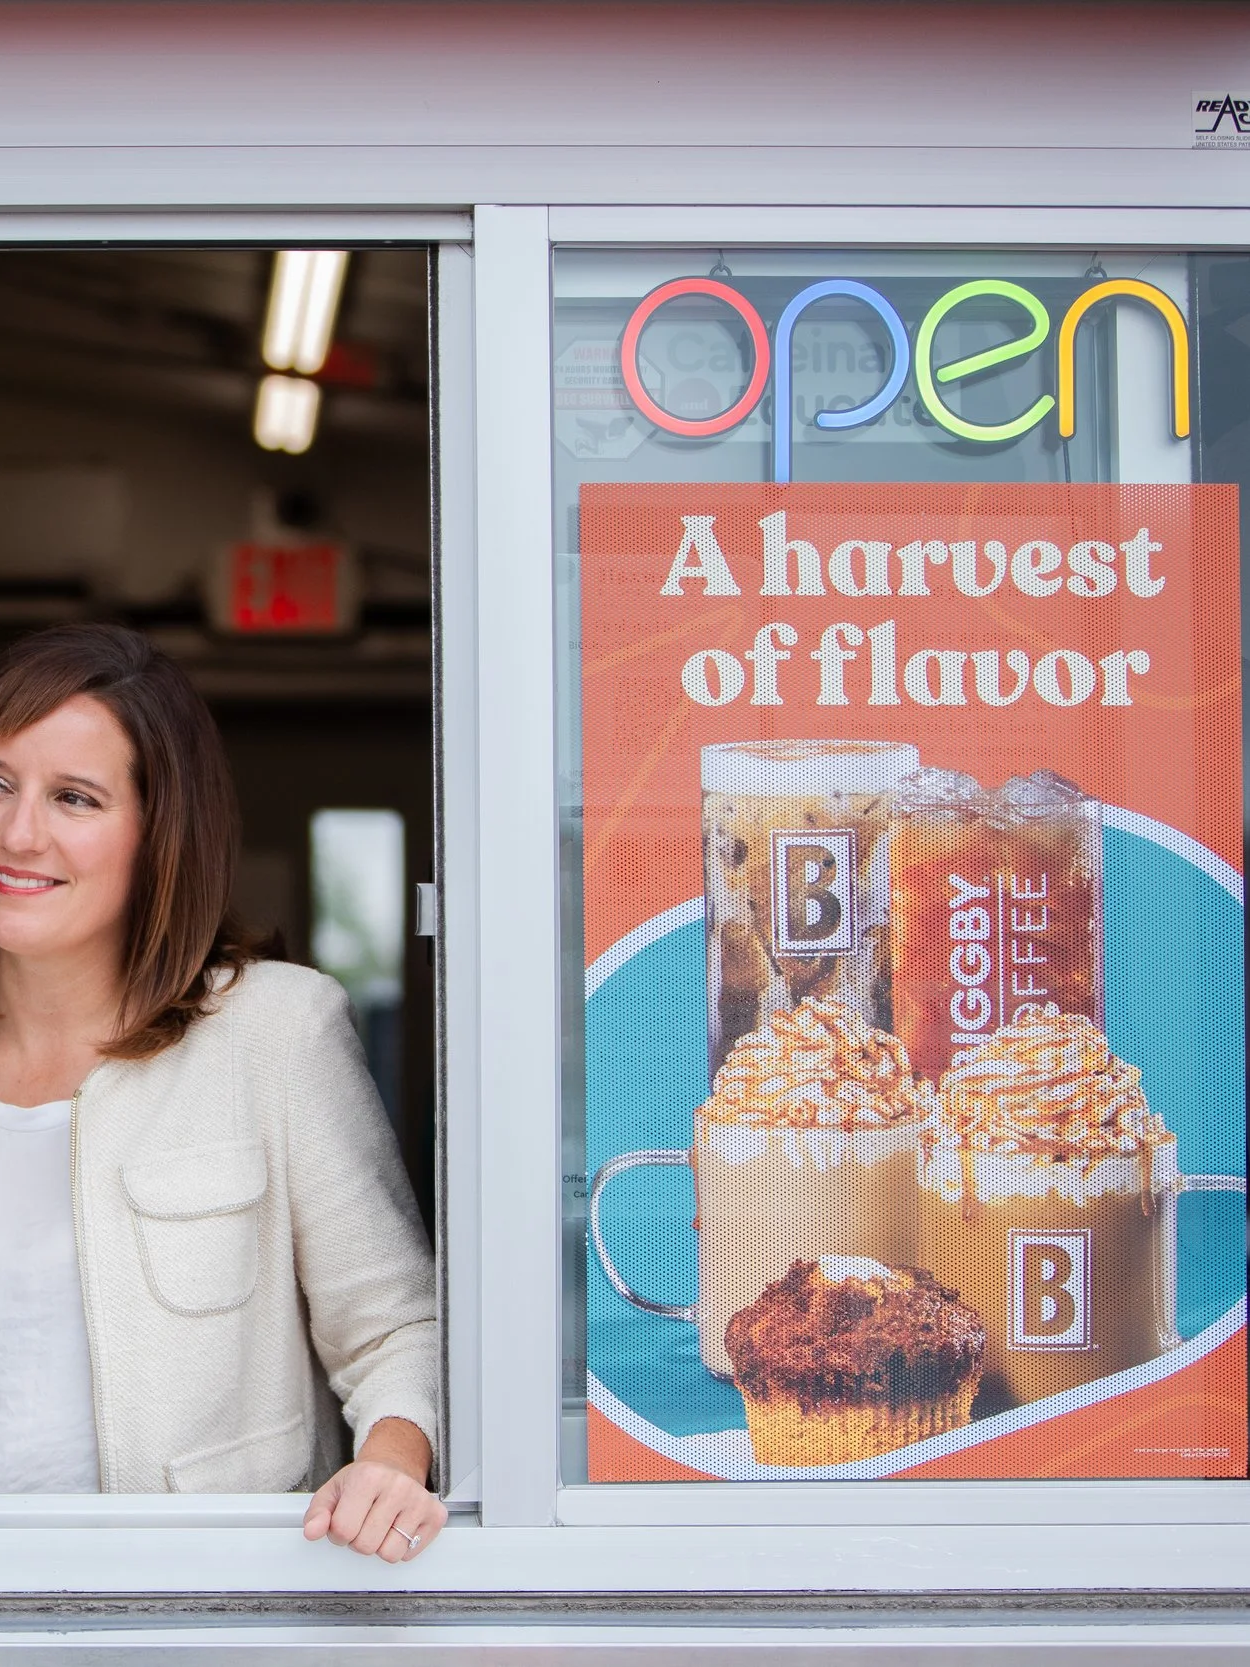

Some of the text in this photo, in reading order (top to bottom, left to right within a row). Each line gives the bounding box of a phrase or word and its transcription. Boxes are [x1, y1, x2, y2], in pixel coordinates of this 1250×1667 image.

[1195, 93, 1250, 133] READ
[621, 277, 1190, 483] open
[659, 510, 1166, 599] A harvest
[681, 619, 1152, 708] of flavor
[785, 844, 842, 943] B
[1022, 1243, 1076, 1337] B
